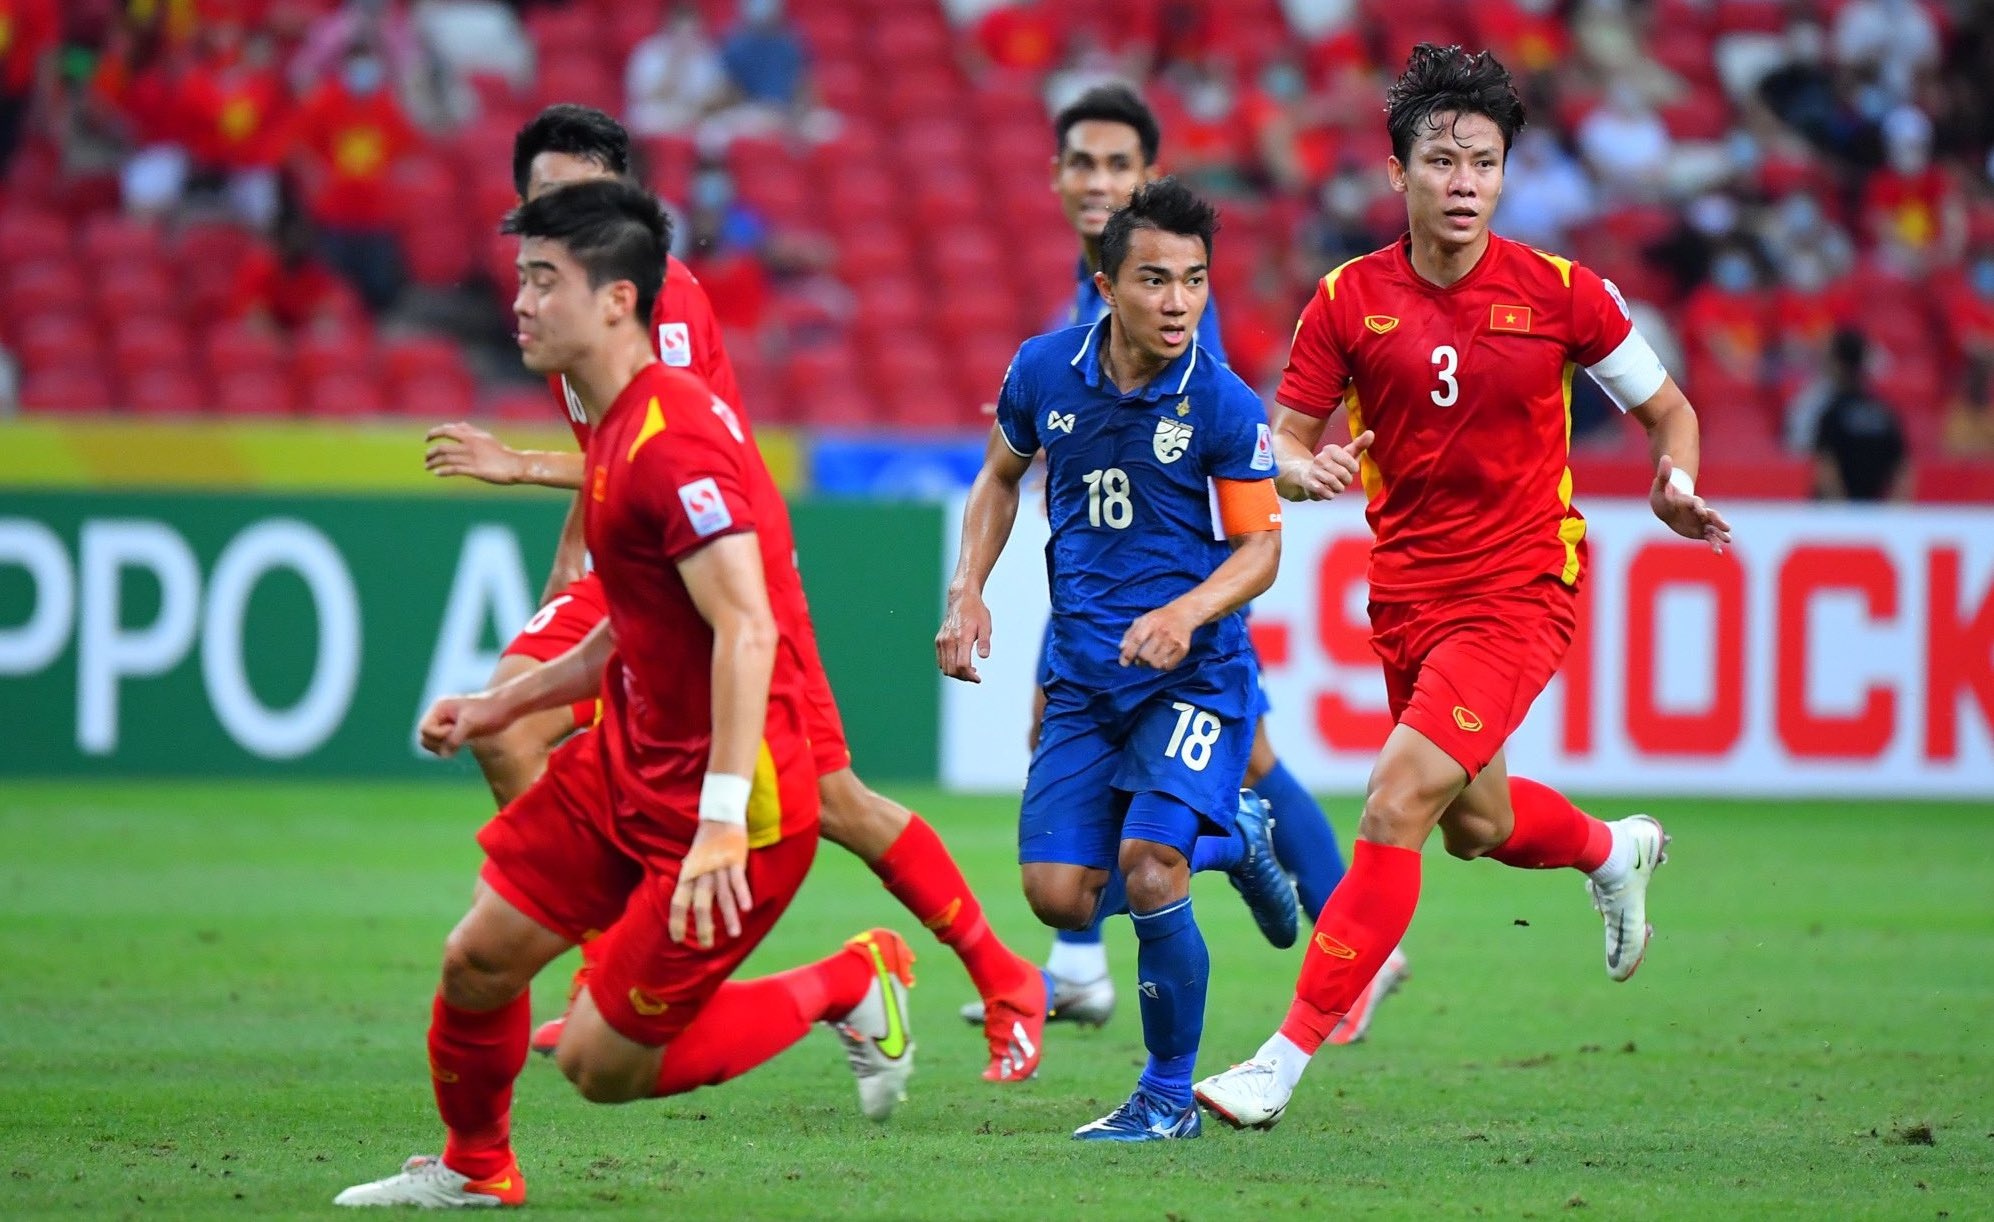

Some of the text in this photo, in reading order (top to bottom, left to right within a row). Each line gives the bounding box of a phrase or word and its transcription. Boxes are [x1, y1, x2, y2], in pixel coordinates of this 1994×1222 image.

[1430, 345, 1459, 407] 3
[1082, 467, 1133, 530] 18
[1165, 701, 1222, 772] 18
